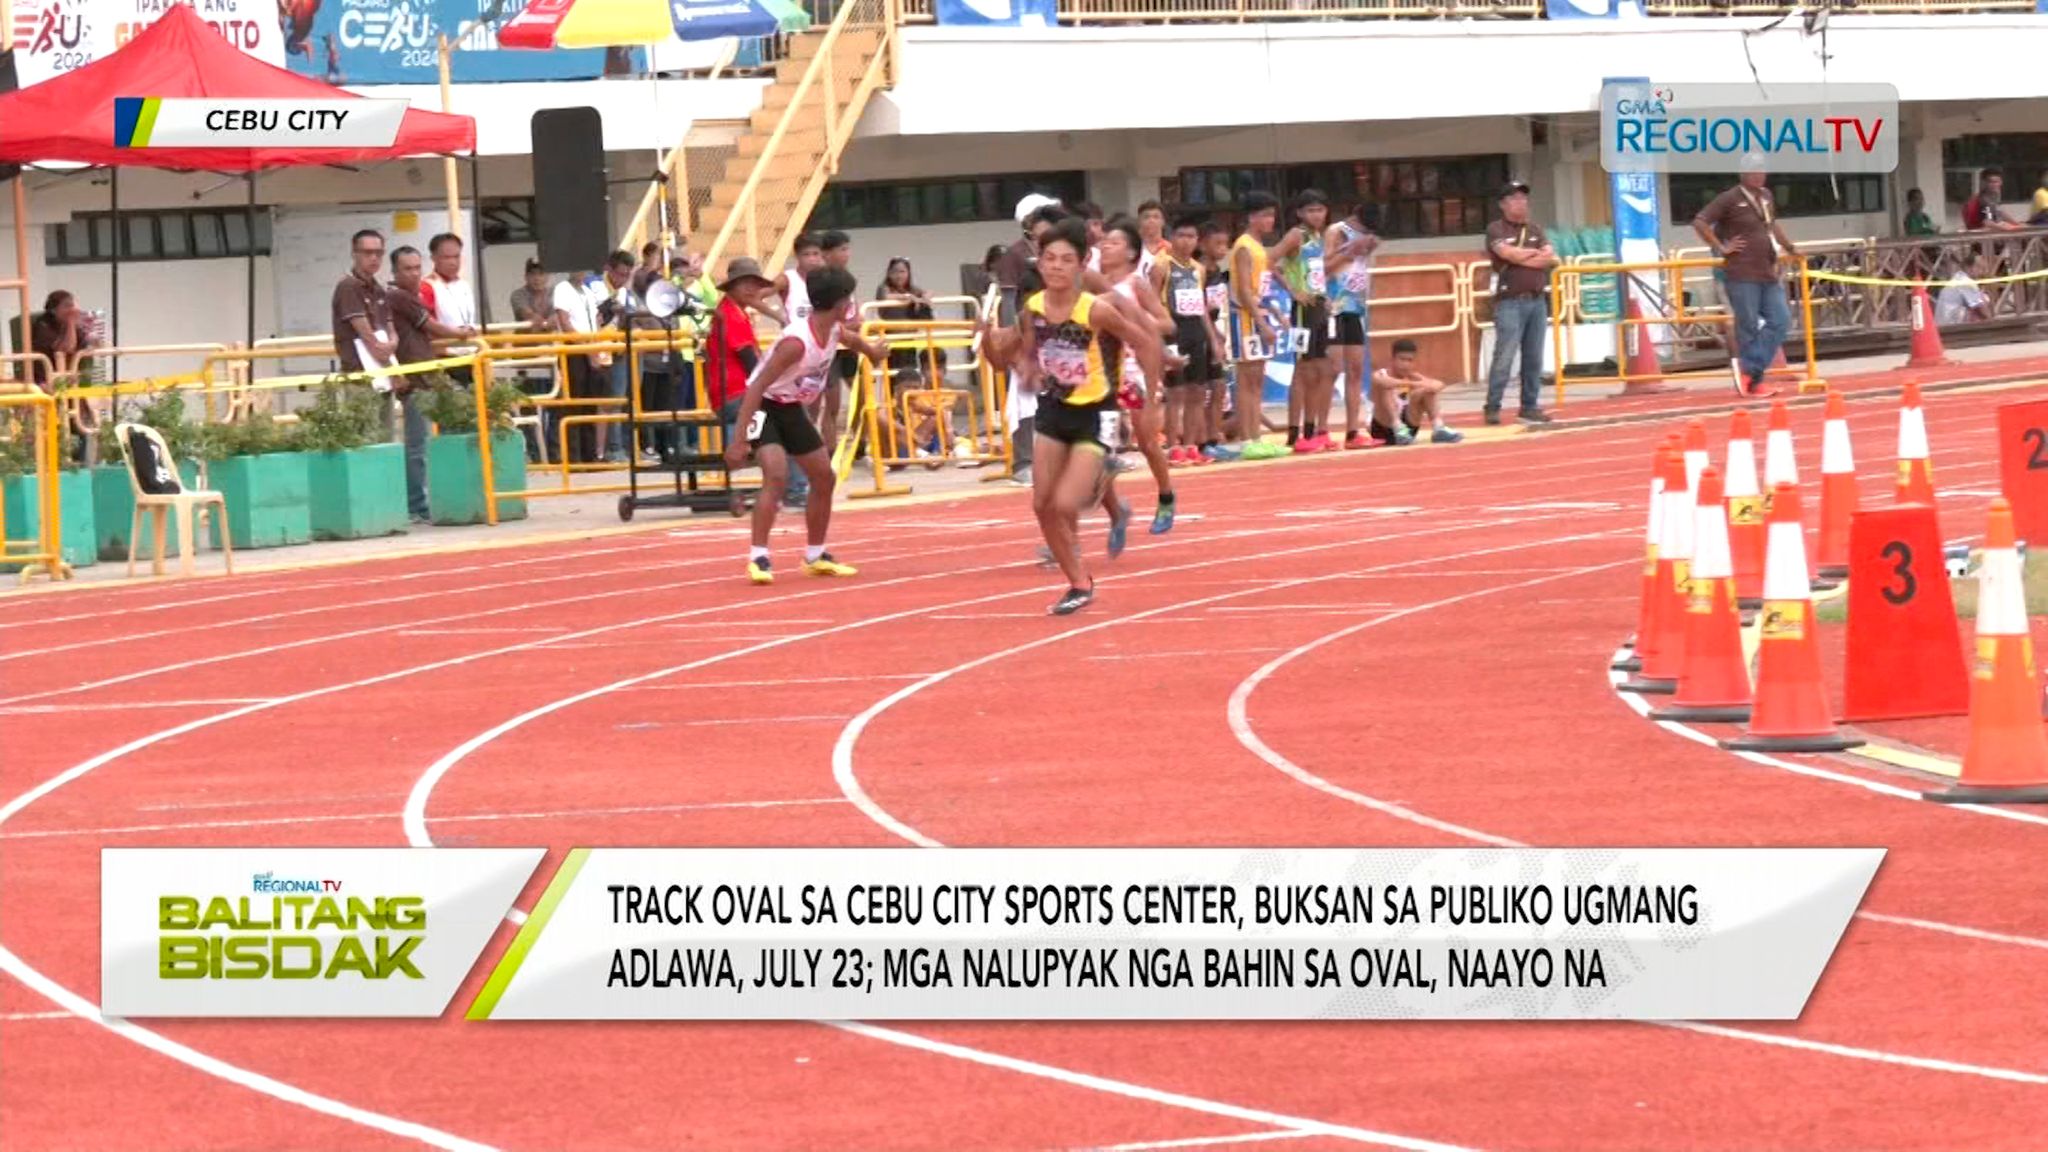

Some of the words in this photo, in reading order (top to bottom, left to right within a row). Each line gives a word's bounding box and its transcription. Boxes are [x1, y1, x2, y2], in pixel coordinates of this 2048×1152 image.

[401, 50, 440, 67] 2024
[2022, 427, 2048, 470] 2
[1880, 540, 1917, 606] 3
